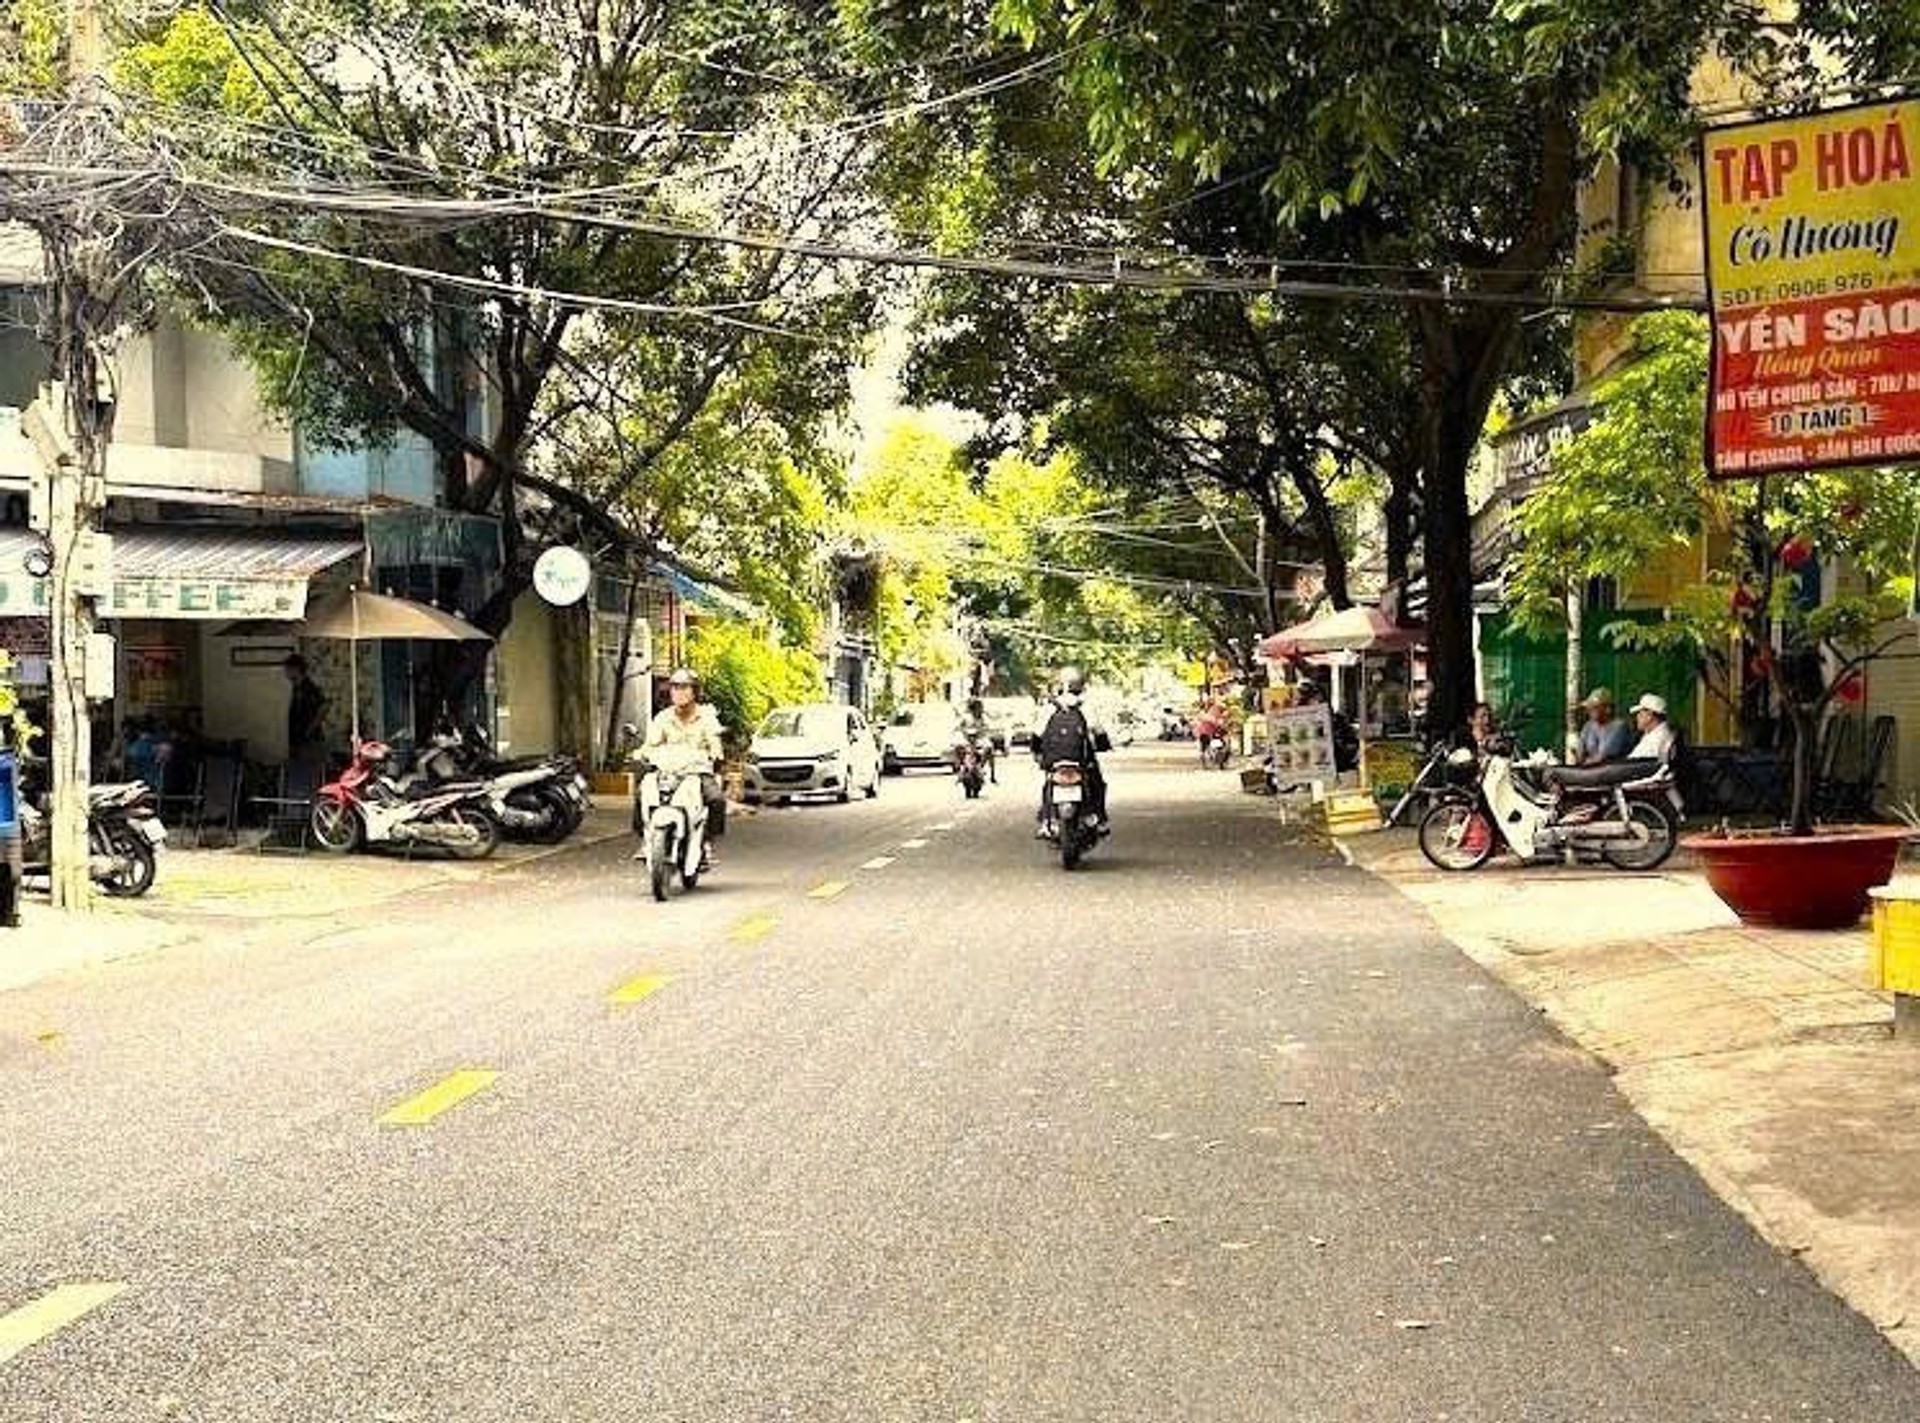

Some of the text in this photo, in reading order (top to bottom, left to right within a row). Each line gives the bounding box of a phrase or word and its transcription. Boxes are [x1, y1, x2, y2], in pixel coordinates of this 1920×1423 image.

[1714, 107, 1912, 215] TẠP HOÁ
[1729, 215, 1899, 267] Cô Hương
[1718, 297, 1920, 355] YẾN SÀO
